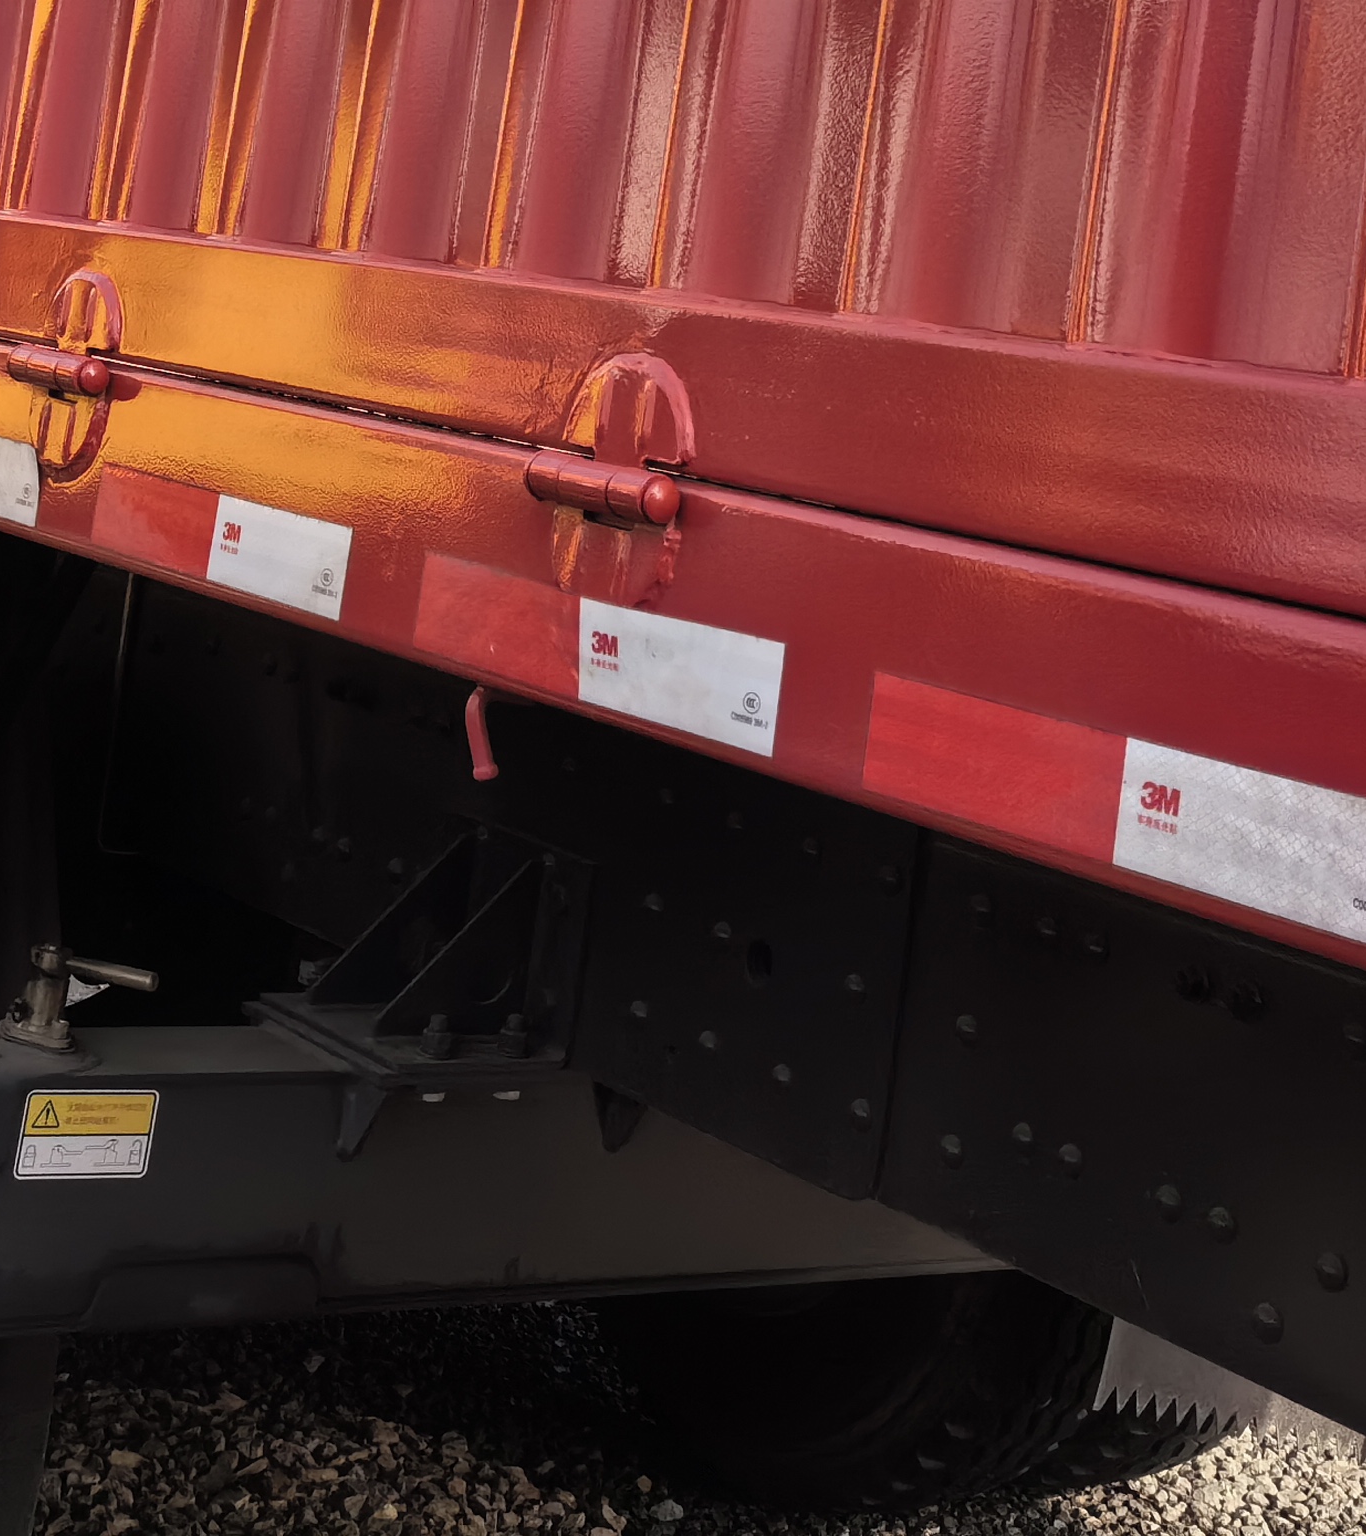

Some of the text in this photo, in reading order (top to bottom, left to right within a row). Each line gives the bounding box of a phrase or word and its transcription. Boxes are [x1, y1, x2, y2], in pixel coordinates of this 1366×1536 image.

[222, 521, 242, 544] 3M
[591, 631, 619, 658] 3M
[1140, 781, 1181, 817] 3M
